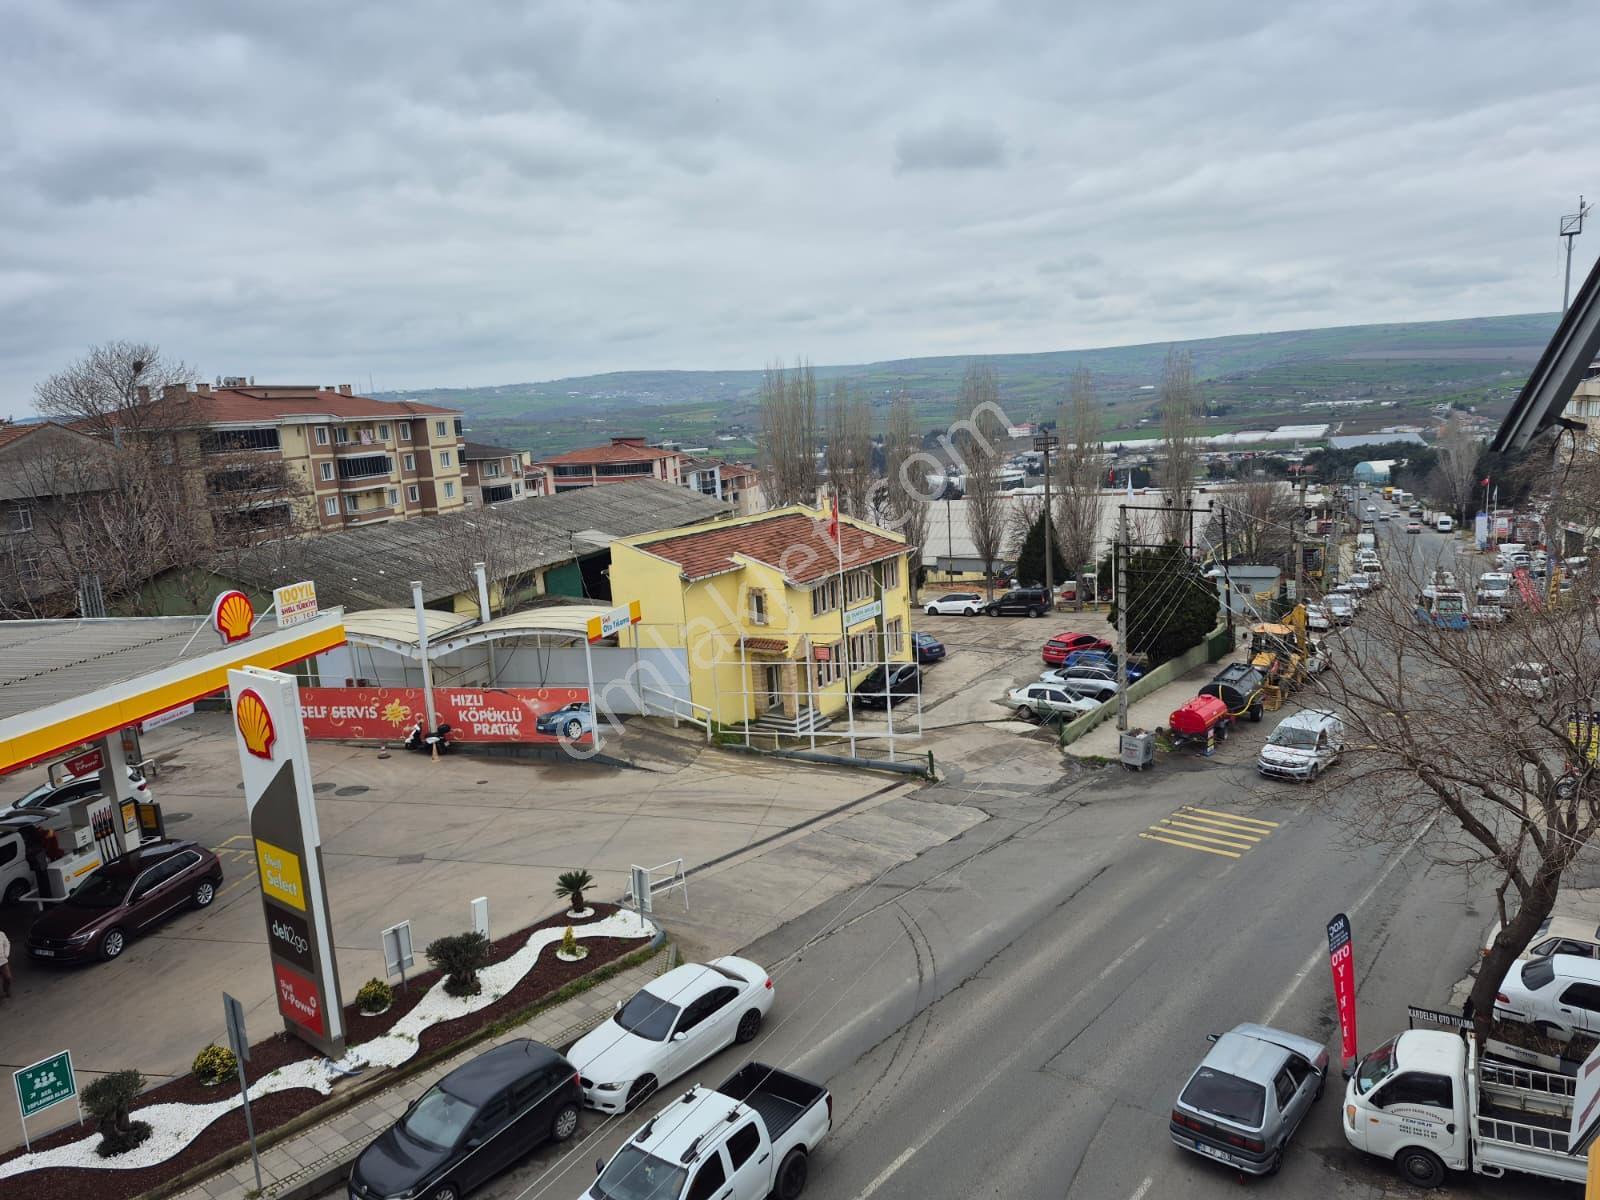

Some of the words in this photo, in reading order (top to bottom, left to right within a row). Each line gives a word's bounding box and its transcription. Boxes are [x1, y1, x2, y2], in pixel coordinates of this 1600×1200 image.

[450, 694, 484, 706] HIZLI
[300, 705, 328, 719] SELF
[458, 706, 522, 722] KÖPÜKLÜ
[266, 870, 298, 897] Select
[272, 920, 309, 954] deli2go
[281, 988, 315, 1018] V-Power
[1438, 1014, 1451, 1025] OTO
